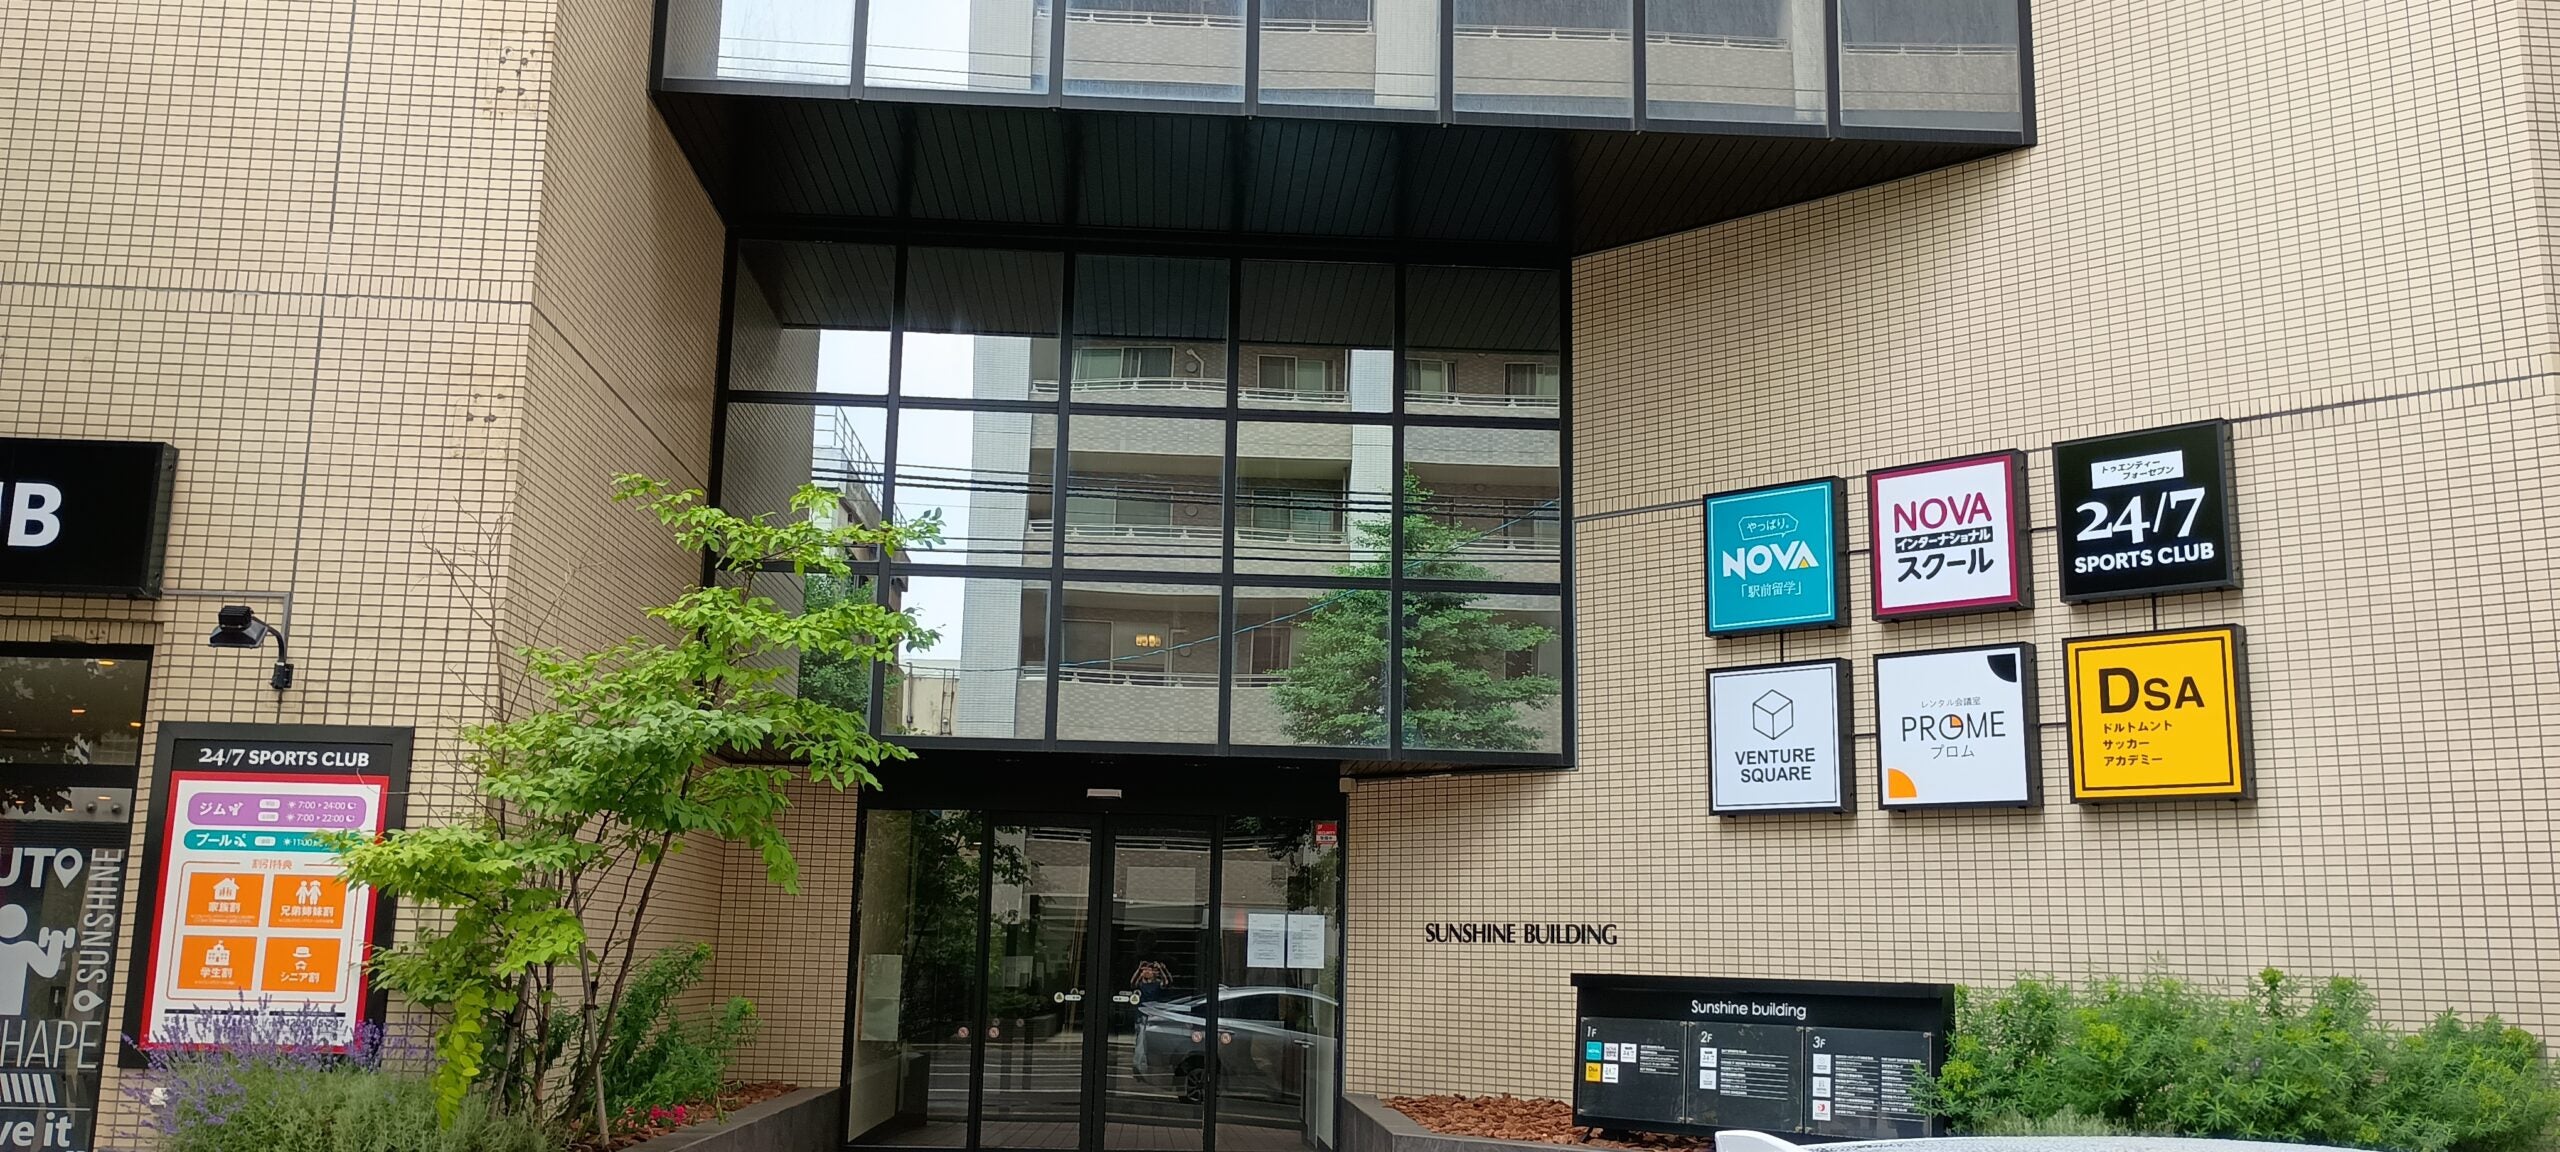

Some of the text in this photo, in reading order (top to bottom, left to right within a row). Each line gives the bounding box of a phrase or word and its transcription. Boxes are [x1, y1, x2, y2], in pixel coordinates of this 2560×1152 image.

[2122, 466, 2175, 481] フォーセブン
[0, 481, 62, 547] B
[1893, 492, 1993, 533] NOVA
[2076, 487, 2206, 544] 24/7
[1896, 528, 1992, 552] インターナショナル
[1722, 540, 1820, 580] NOVA
[1897, 547, 1995, 583] スクール
[2074, 542, 2215, 574] SPORTS CLUB
[2098, 667, 2205, 714] DSA
[1921, 696, 1982, 708] レンタル会議室
[1901, 710, 2006, 742] PROME
[2103, 720, 2173, 734] ドルトムント
[1930, 744, 1975, 760] プロム
[2103, 738, 2150, 750] サッカー
[198, 748, 370, 767] 24/7 SPORTS CLUB
[1734, 747, 1816, 766] VENTURE
[2103, 754, 2163, 767] アカデミー
[1740, 765, 1812, 783] SQUARE
[199, 801, 226, 817] ジム
[323, 802, 346, 810] 24:00
[296, 814, 345, 823] 7:00 22:00
[196, 833, 232, 847] プール
[76, 848, 126, 984] SUNSHINE
[1425, 923, 1618, 945] SUNSHINE BUILDING
[280, 971, 320, 984] シニア割
[1691, 1000, 1807, 1020] Sunshine building
[1700, 1030, 1713, 1043] 2F
[1812, 1035, 1826, 1048] 3F
[43, 1111, 72, 1147] it
